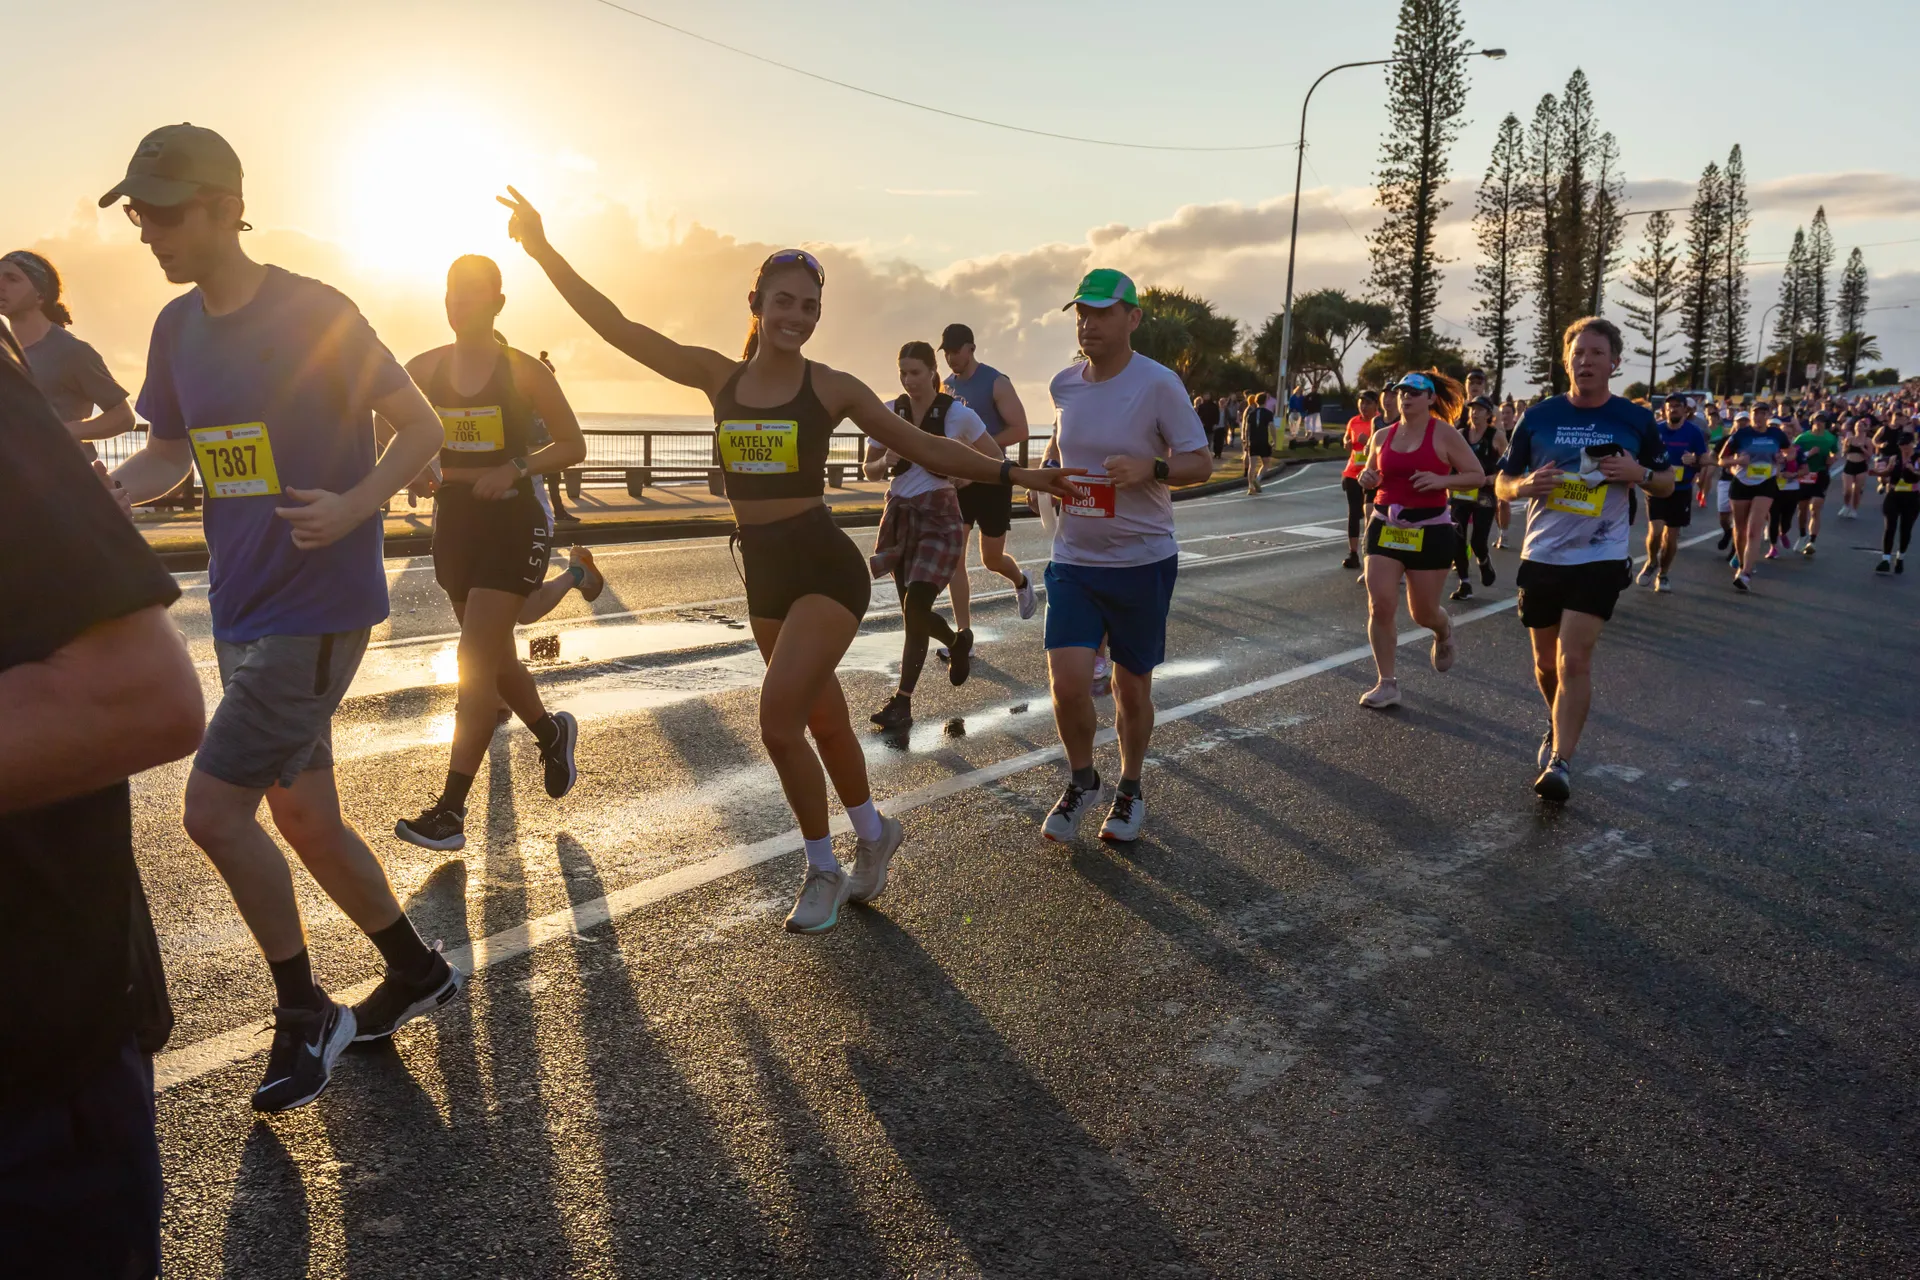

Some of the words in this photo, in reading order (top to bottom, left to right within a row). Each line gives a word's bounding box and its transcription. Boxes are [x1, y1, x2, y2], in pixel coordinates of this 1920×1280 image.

[456, 421, 477, 431] ZOE
[453, 431, 481, 442] 7061
[730, 435, 783, 448] KATELYN
[1592, 431, 1613, 440] Coast
[206, 444, 257, 478] 7387
[740, 448, 772, 461] 7062
[523, 528, 547, 584] LSKD
